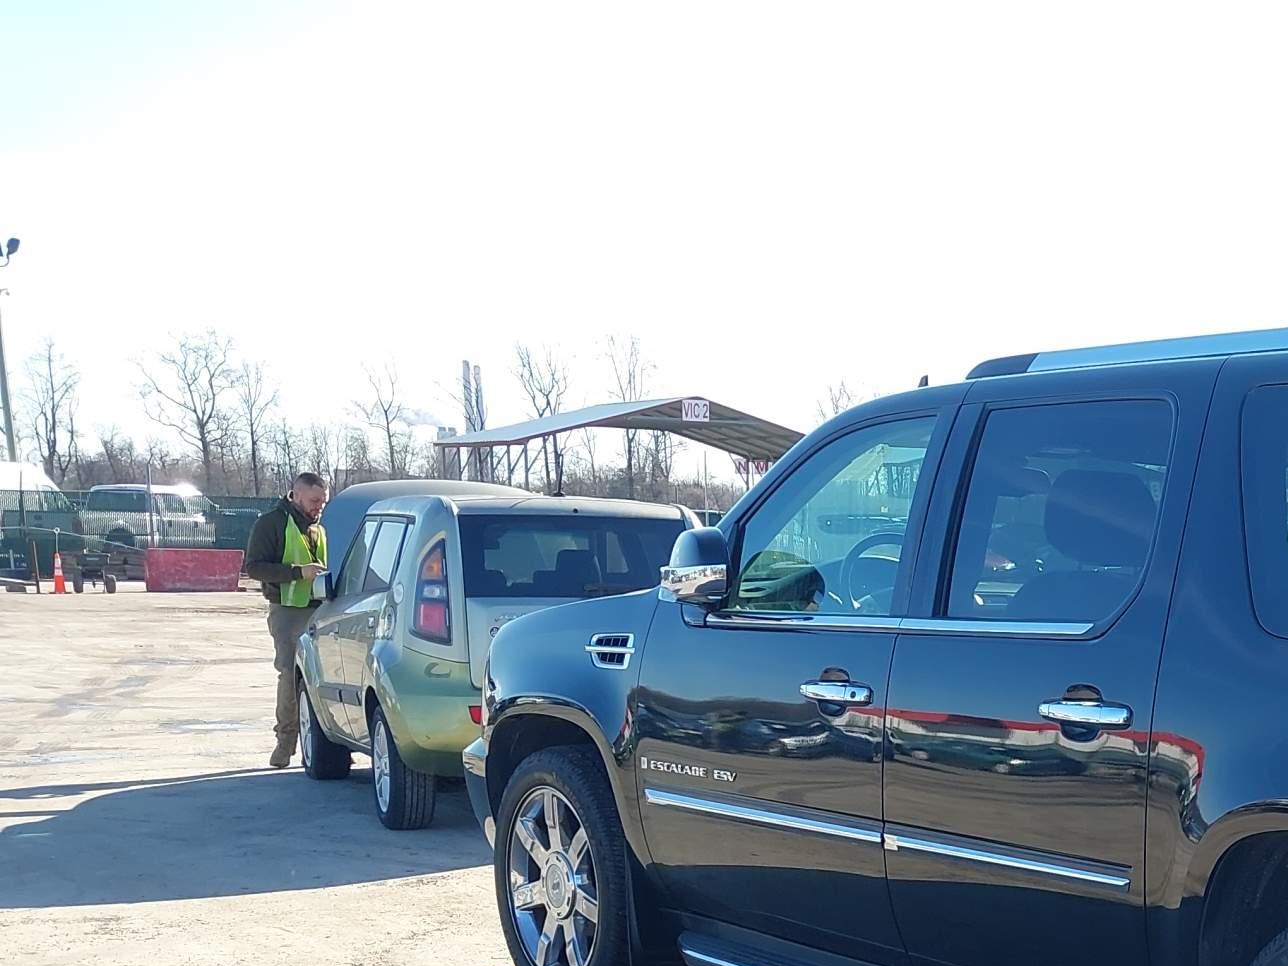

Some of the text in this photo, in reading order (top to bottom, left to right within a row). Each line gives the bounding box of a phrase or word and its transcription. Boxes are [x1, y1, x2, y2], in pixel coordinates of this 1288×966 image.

[683, 402, 709, 419] VIC 2
[650, 760, 737, 782] ESCALADE ESV
